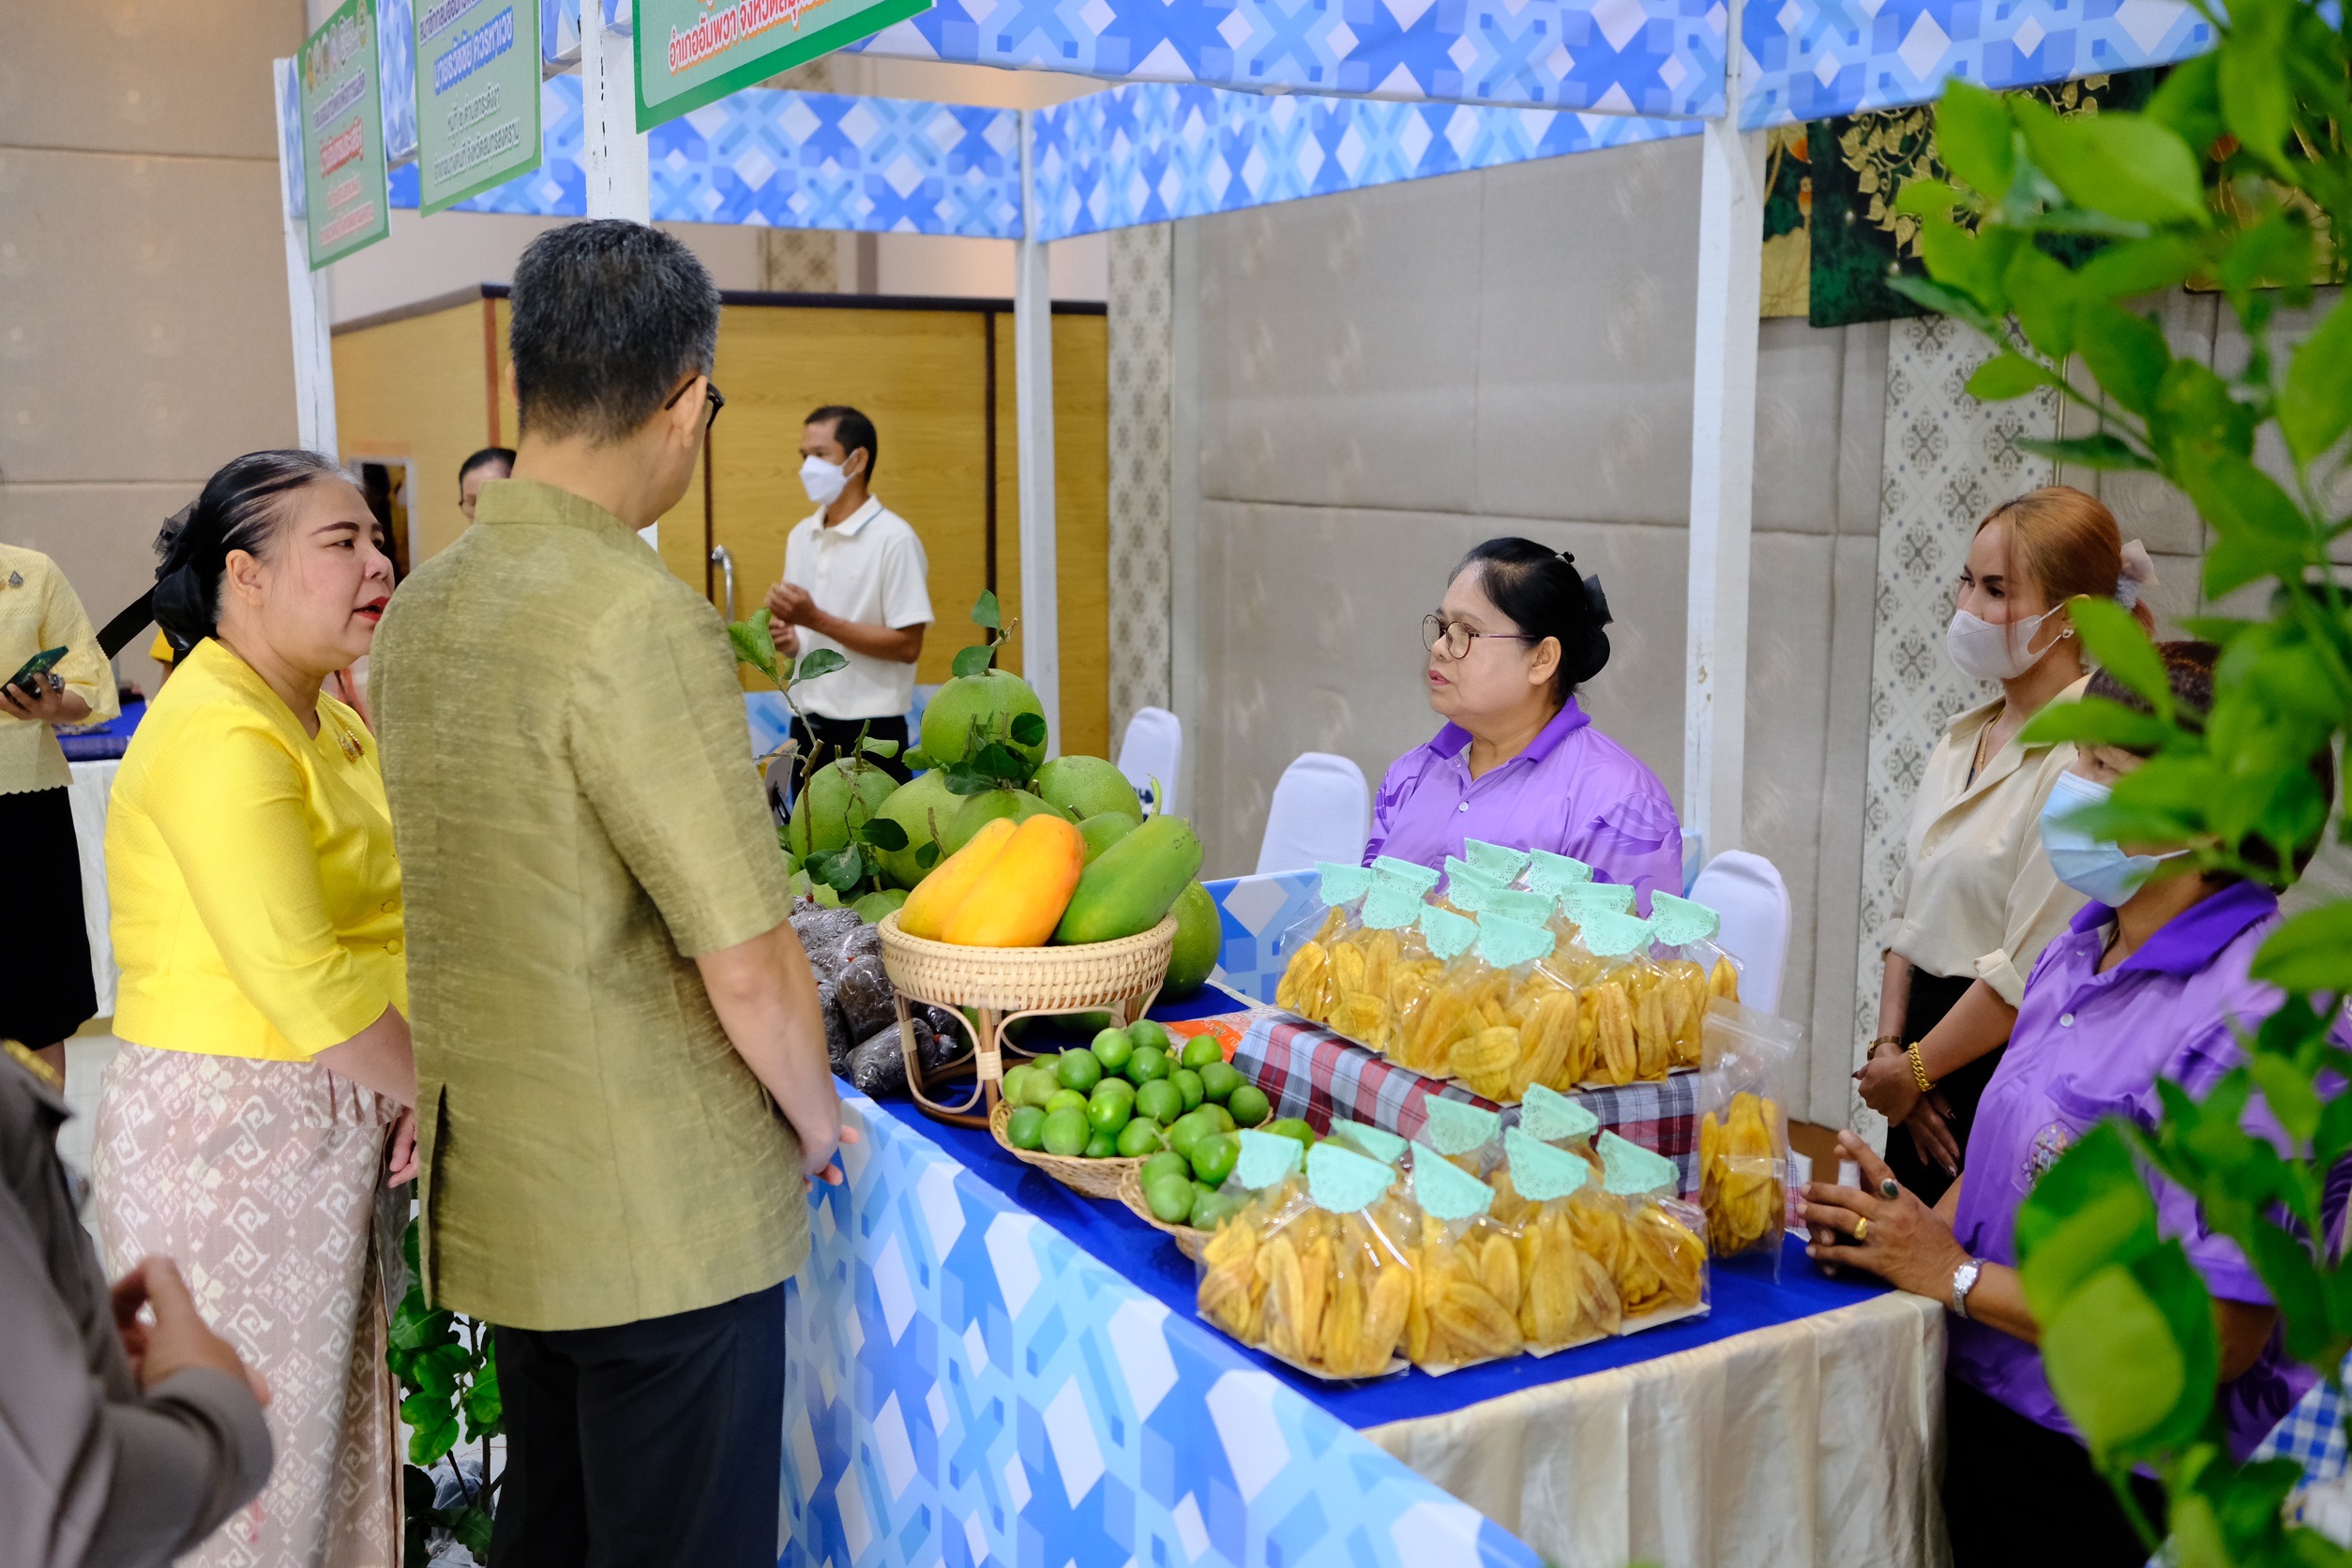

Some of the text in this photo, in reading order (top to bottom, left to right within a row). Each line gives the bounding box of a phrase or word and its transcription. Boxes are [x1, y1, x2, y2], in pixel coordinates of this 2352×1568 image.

[669, 5, 737, 75] อำเภออัมพวา
